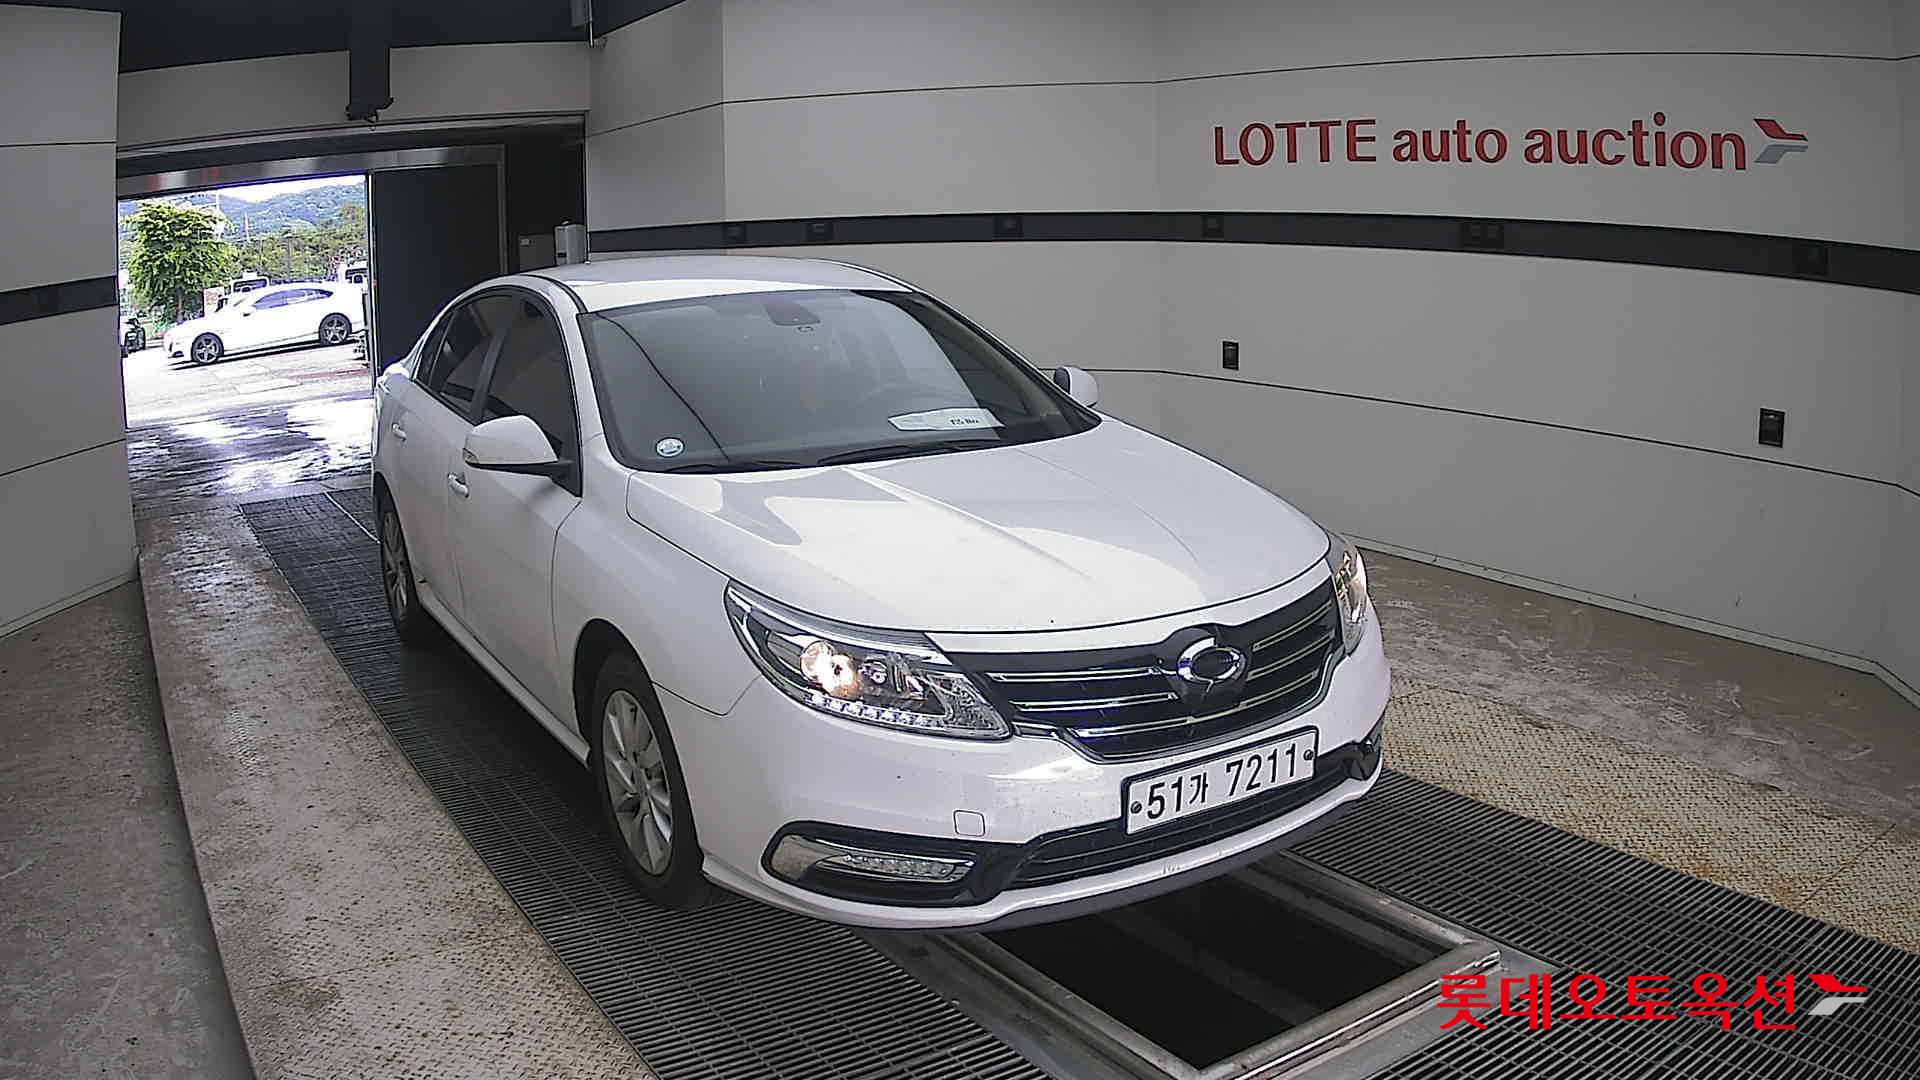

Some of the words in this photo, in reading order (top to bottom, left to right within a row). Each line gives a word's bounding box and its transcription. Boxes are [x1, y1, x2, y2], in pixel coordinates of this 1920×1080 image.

[1214, 118, 1377, 166] LOTTE
[1392, 119, 1507, 164] auto
[1523, 111, 1747, 170] auction
[1147, 771, 1209, 820] 51가
[1225, 743, 1297, 797] 7211
